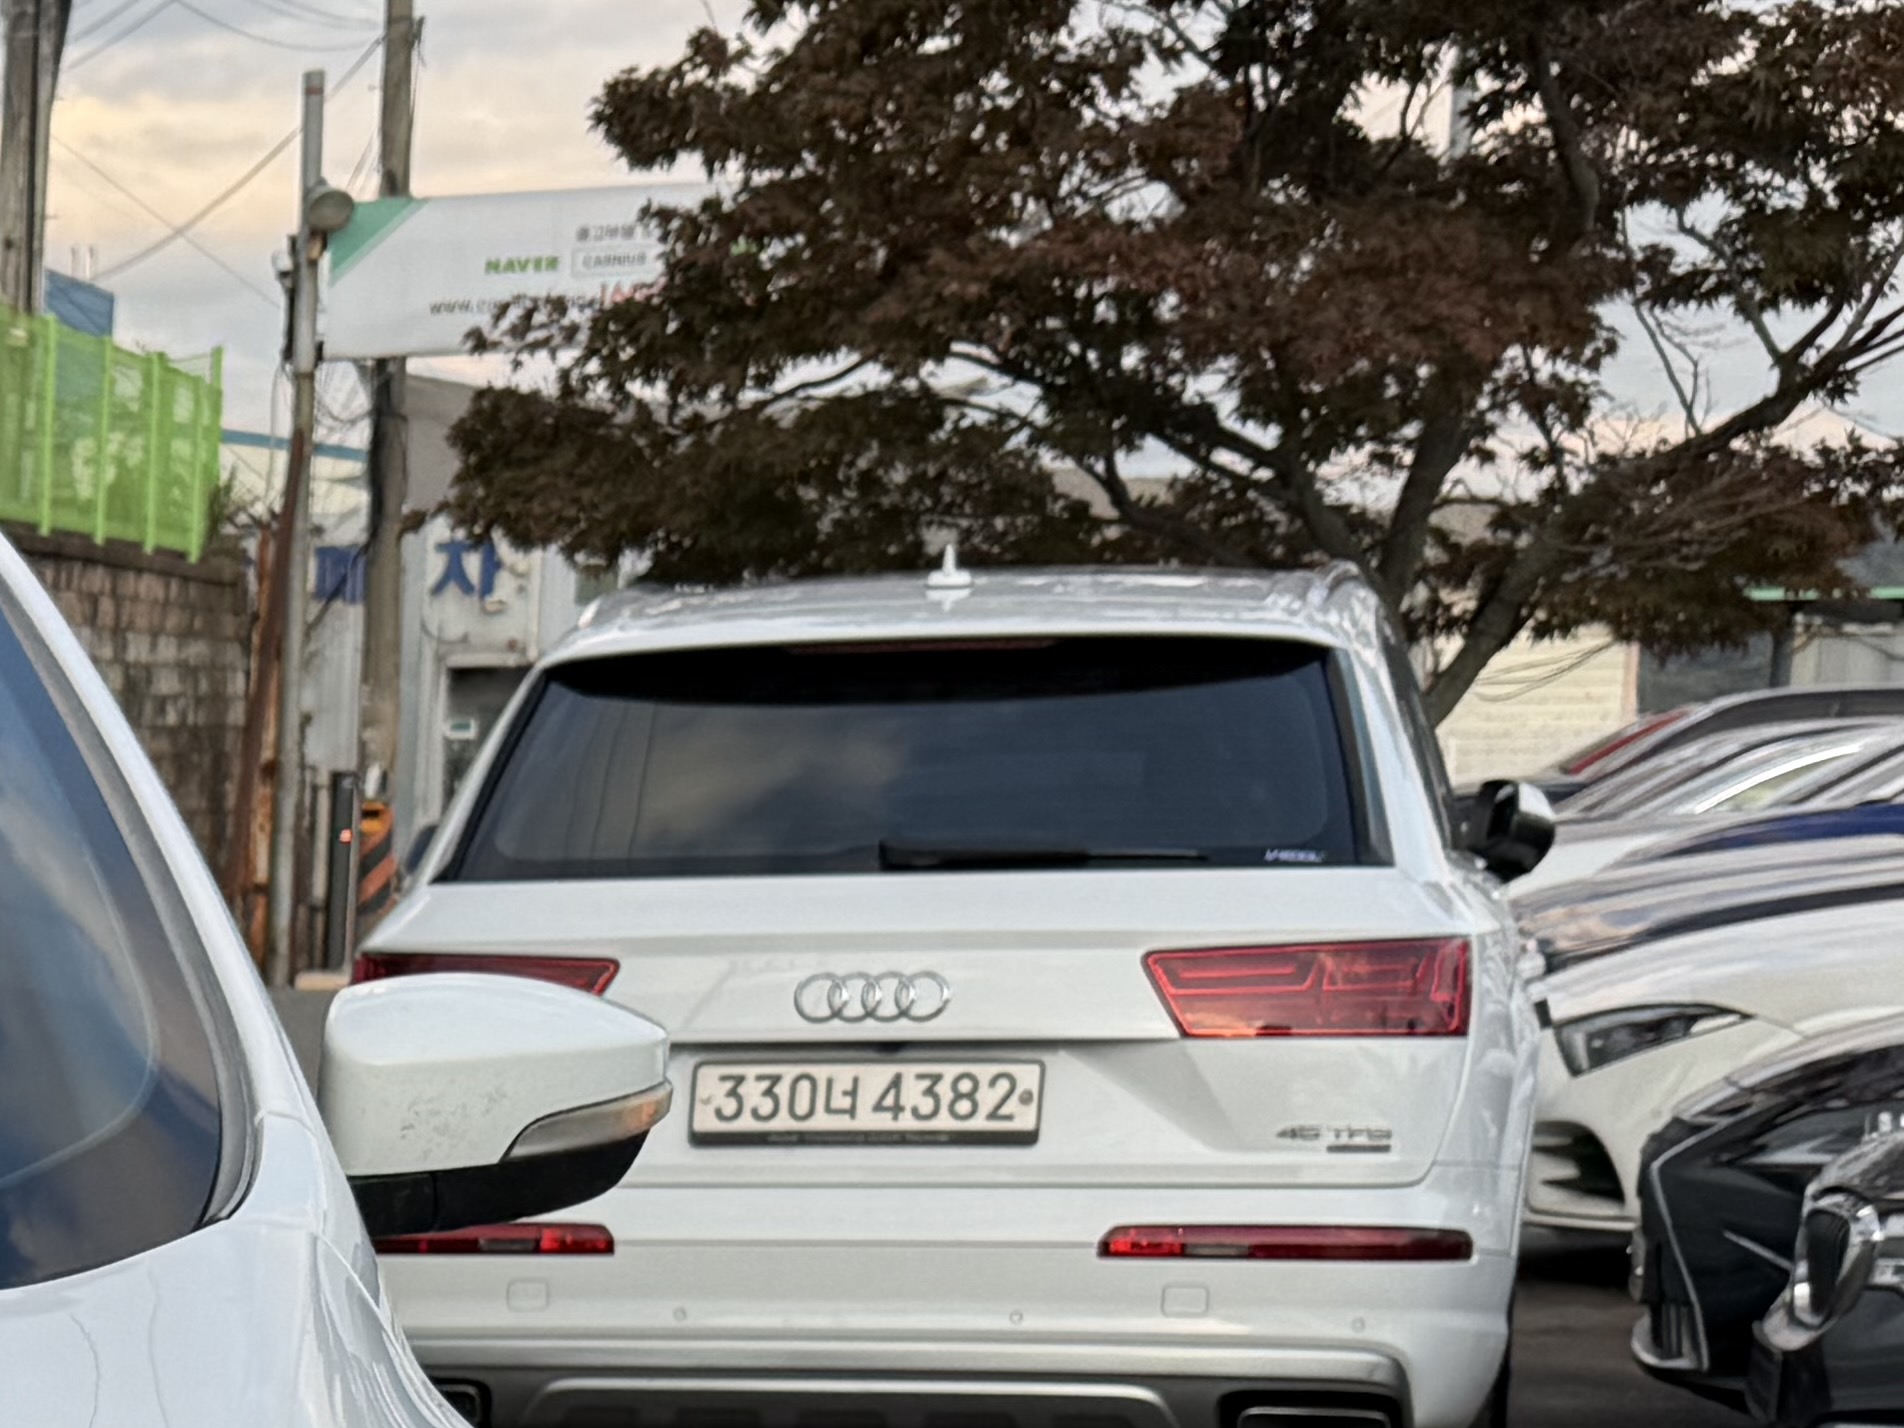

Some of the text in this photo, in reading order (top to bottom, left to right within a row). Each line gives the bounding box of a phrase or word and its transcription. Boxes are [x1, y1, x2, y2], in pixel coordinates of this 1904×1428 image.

[484, 256, 560, 275] NAVER
[713, 1071, 1018, 1122] 330너 4382
